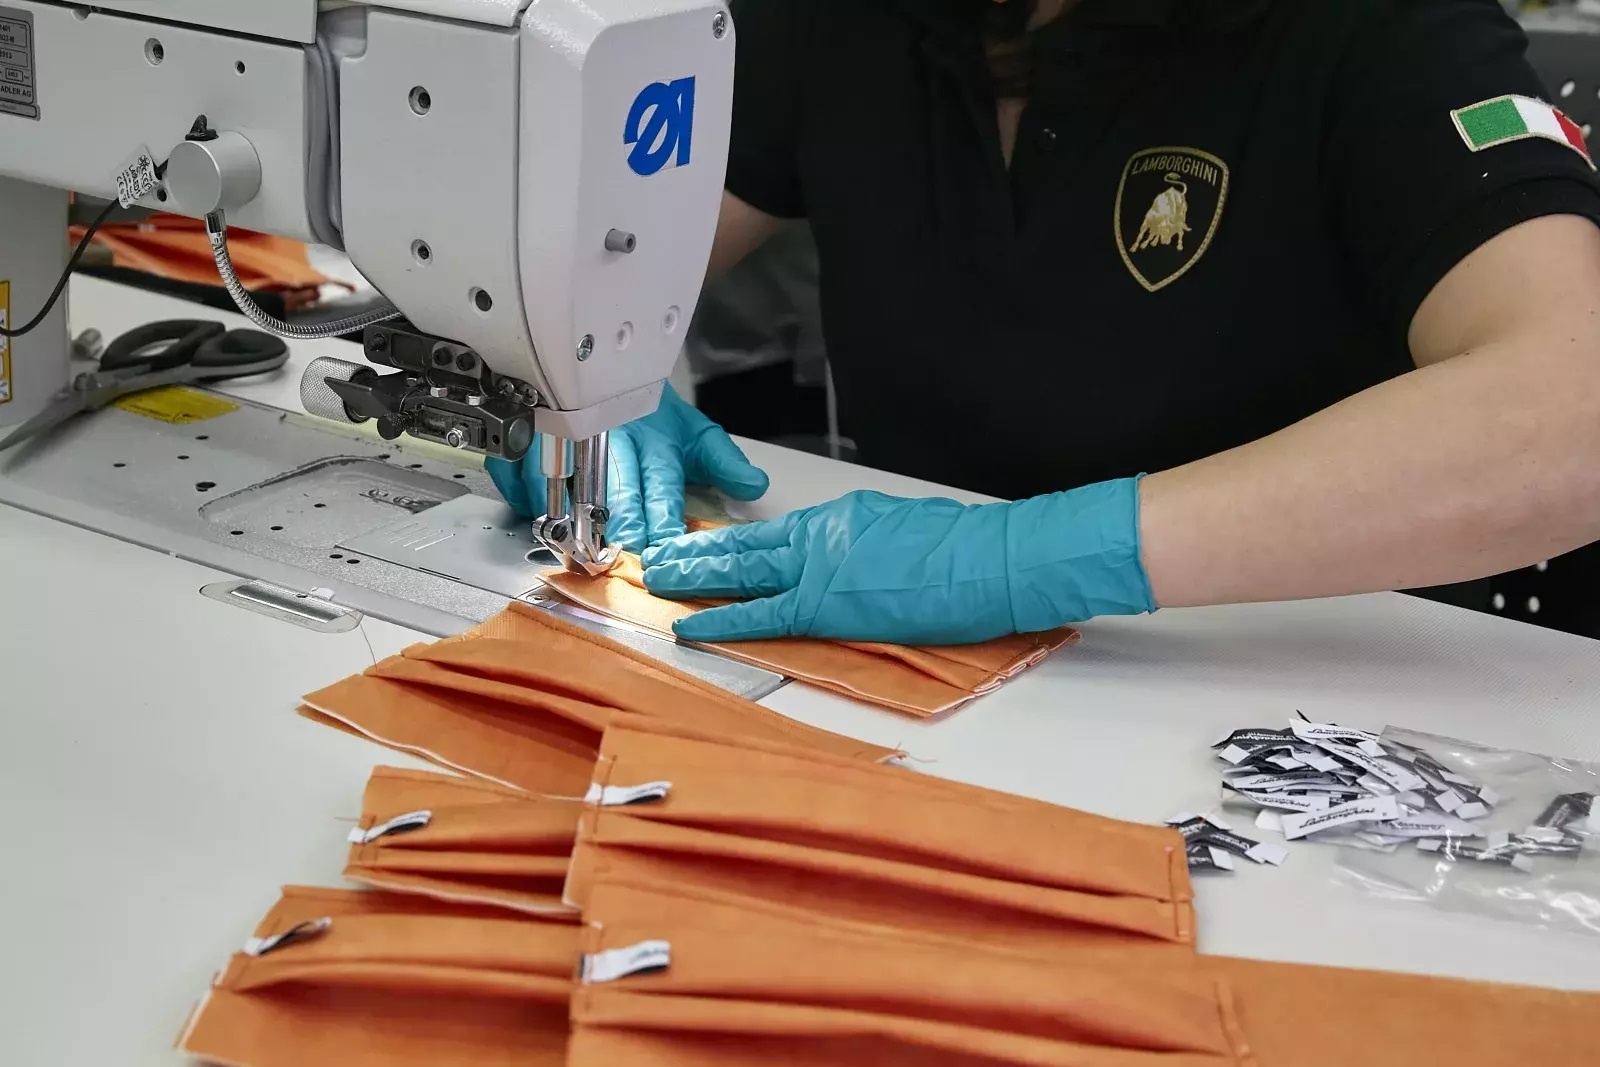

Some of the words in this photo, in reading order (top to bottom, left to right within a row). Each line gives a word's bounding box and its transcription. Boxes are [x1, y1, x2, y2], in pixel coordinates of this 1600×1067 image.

[0, 85, 21, 96] ADLER
[22, 89, 32, 98] AG
[1131, 155, 1218, 187] LAMBORGHINI
[1299, 807, 1376, 829] Lamborghini
